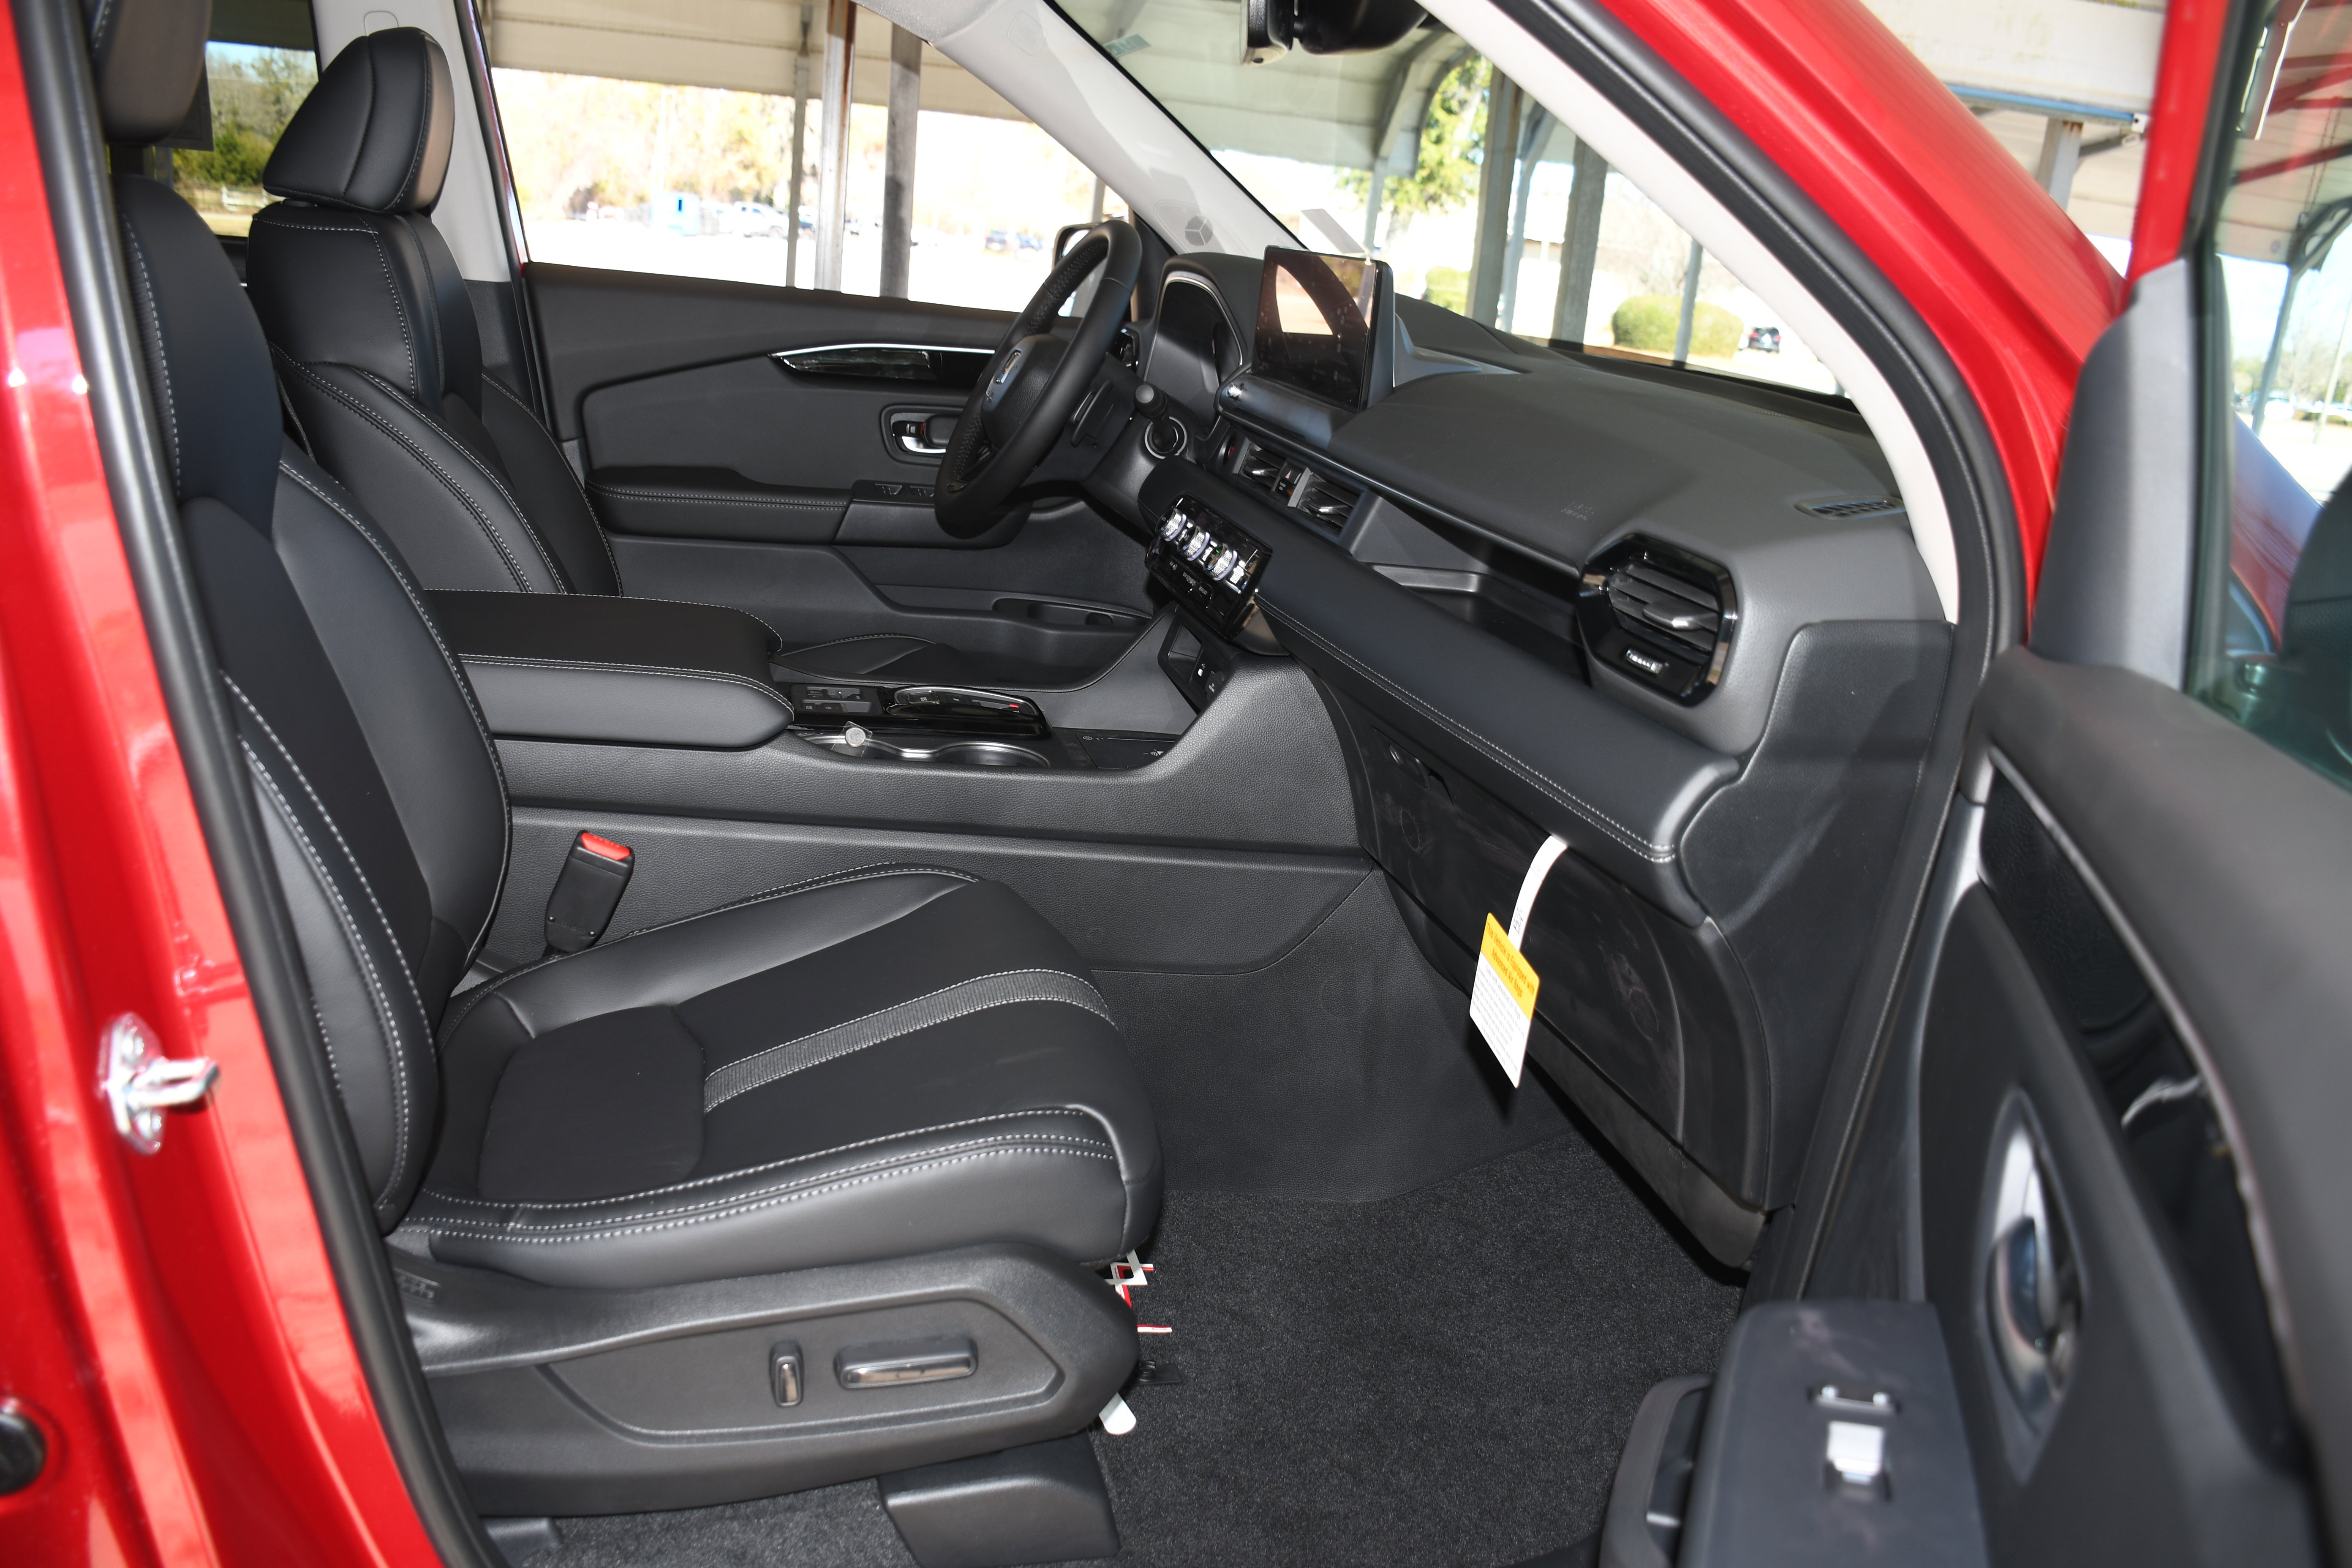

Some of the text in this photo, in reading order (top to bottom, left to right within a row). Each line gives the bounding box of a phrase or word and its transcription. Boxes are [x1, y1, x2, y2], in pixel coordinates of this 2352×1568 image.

[1491, 948, 1508, 977] Advanced
[1514, 979, 1522, 998] Bags
[1494, 932, 1506, 956] Vehicle
[1506, 951, 1510, 962] is
[1510, 956, 1527, 984] Equipped
[1526, 979, 1535, 996] with
